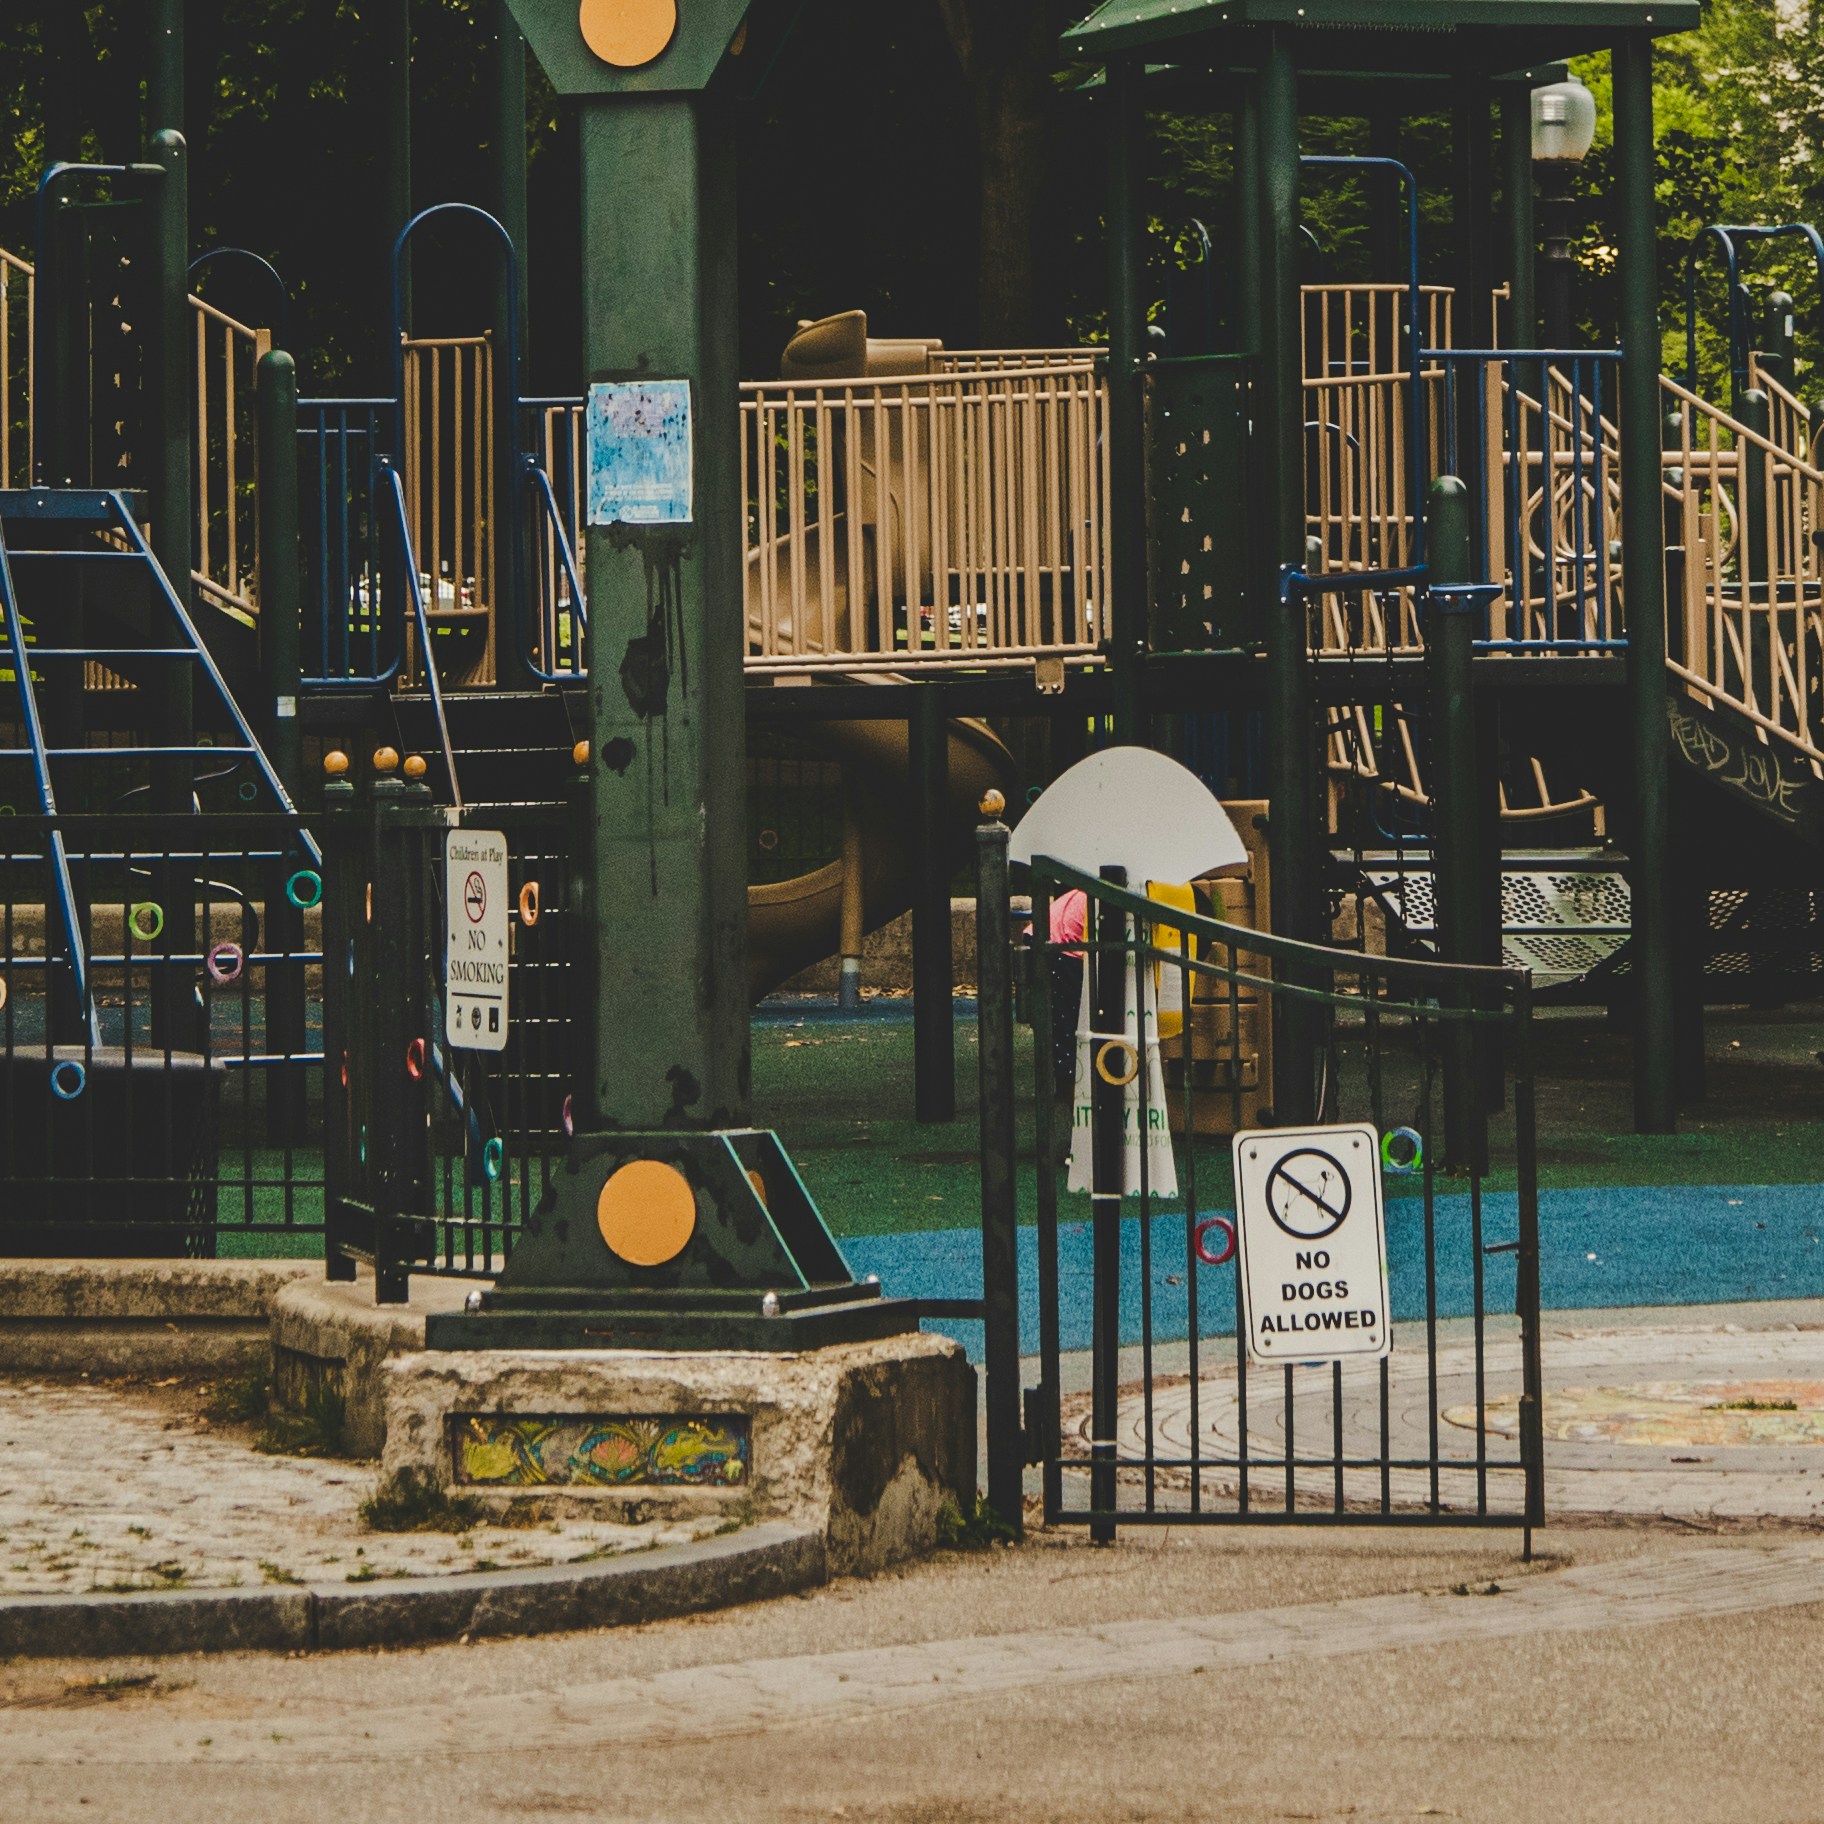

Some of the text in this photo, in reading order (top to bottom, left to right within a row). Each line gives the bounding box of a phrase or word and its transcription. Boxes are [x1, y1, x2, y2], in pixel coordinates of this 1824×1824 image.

[450, 846, 503, 866] Children at Play
[468, 930, 486, 951] NO
[450, 960, 504, 984] SMOKING
[1296, 1251, 1330, 1269] NO
[1282, 1280, 1349, 1301] DOGS
[1260, 1310, 1376, 1333] ALLOWED
